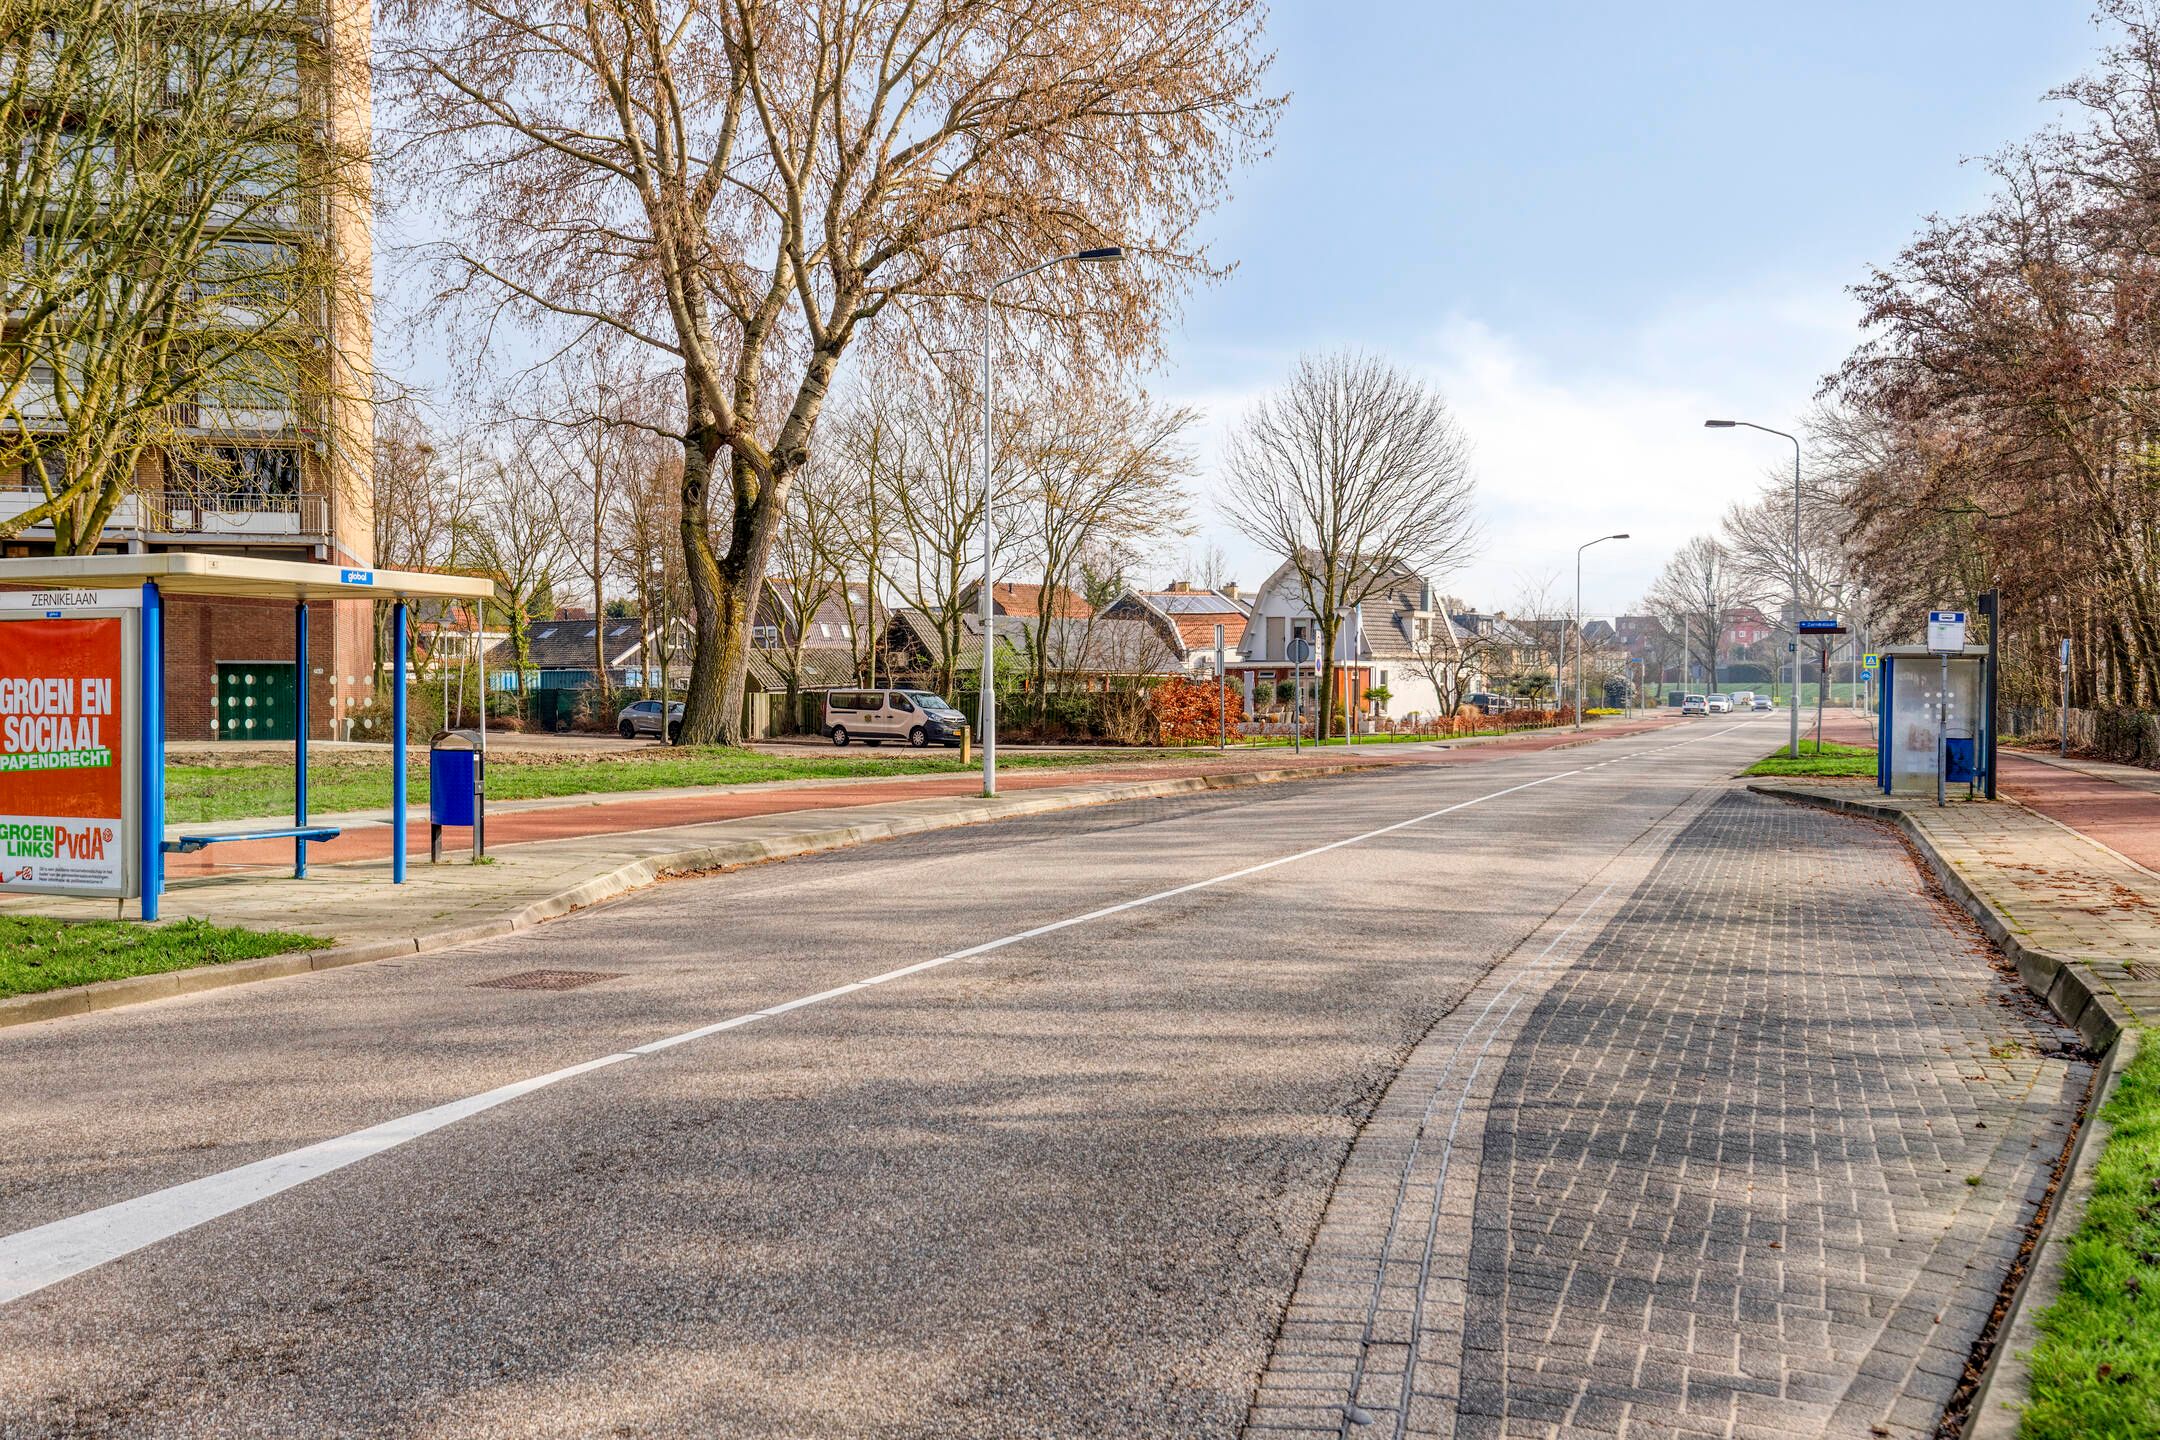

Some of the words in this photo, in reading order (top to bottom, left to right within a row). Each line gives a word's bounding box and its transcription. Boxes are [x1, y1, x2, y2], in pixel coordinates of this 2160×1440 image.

[347, 571, 367, 583] global
[31, 592, 98, 607] ZERNIKELAAN
[0, 677, 74, 715] GROEN
[81, 678, 112, 715] EN
[4, 715, 106, 753] SOCIAAL
[0, 750, 110, 770] PAPENDRECHT
[0, 824, 54, 842] GROEN
[54, 825, 105, 860] PvdA
[7, 841, 54, 858] LINKS
